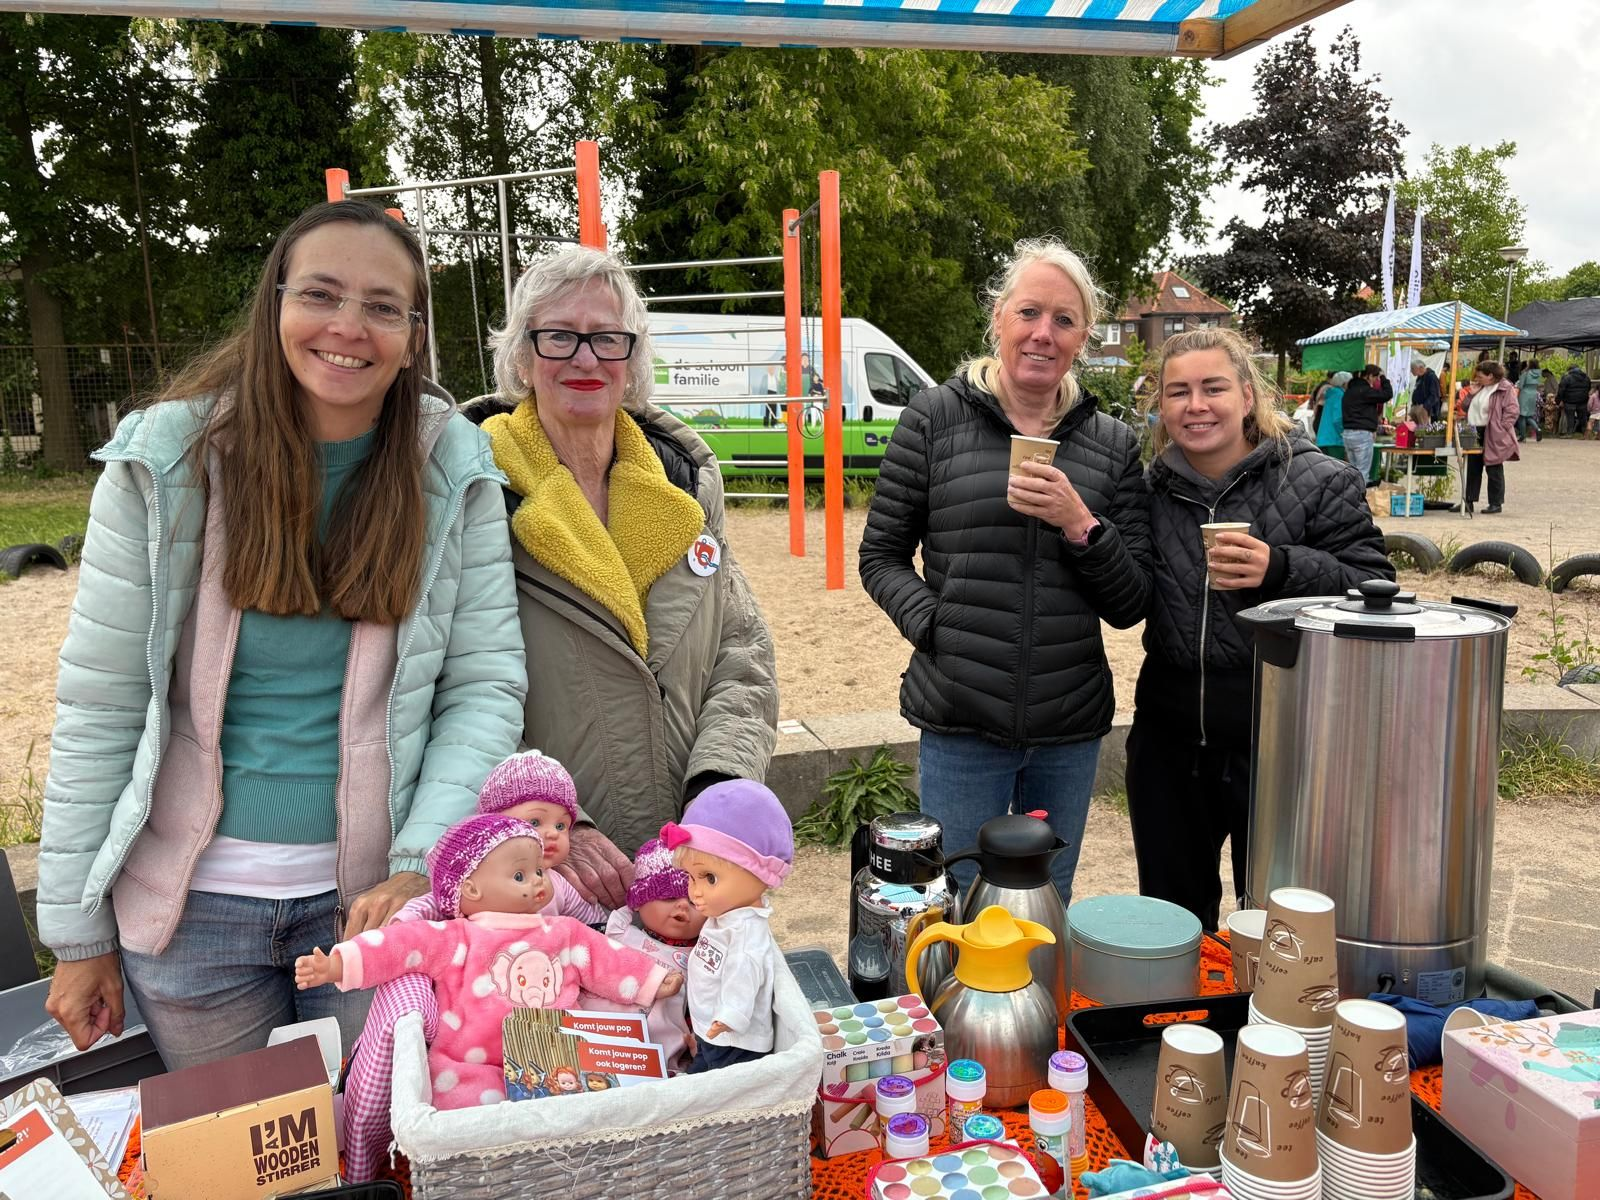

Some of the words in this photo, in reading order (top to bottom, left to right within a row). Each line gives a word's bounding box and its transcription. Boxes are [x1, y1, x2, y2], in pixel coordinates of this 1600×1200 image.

[673, 373, 720, 386] familie
[1303, 956, 1324, 966] café
[1265, 961, 1288, 975] coffee
[573, 1022, 595, 1030] Komt
[596, 1022, 615, 1031] jouw
[616, 1024, 631, 1032] pop
[588, 1047, 610, 1055] Komt
[611, 1049, 630, 1058] jouw
[632, 1052, 647, 1060] pop
[827, 1051, 847, 1060] Chalk
[612, 1061, 646, 1070] logeren?
[1166, 1106, 1191, 1120] coffee
[1368, 1116, 1384, 1125] tee
[1277, 1145, 1292, 1153] tee
[254, 1138, 319, 1175] WOODEN
[256, 1158, 320, 1186] STIRRER
